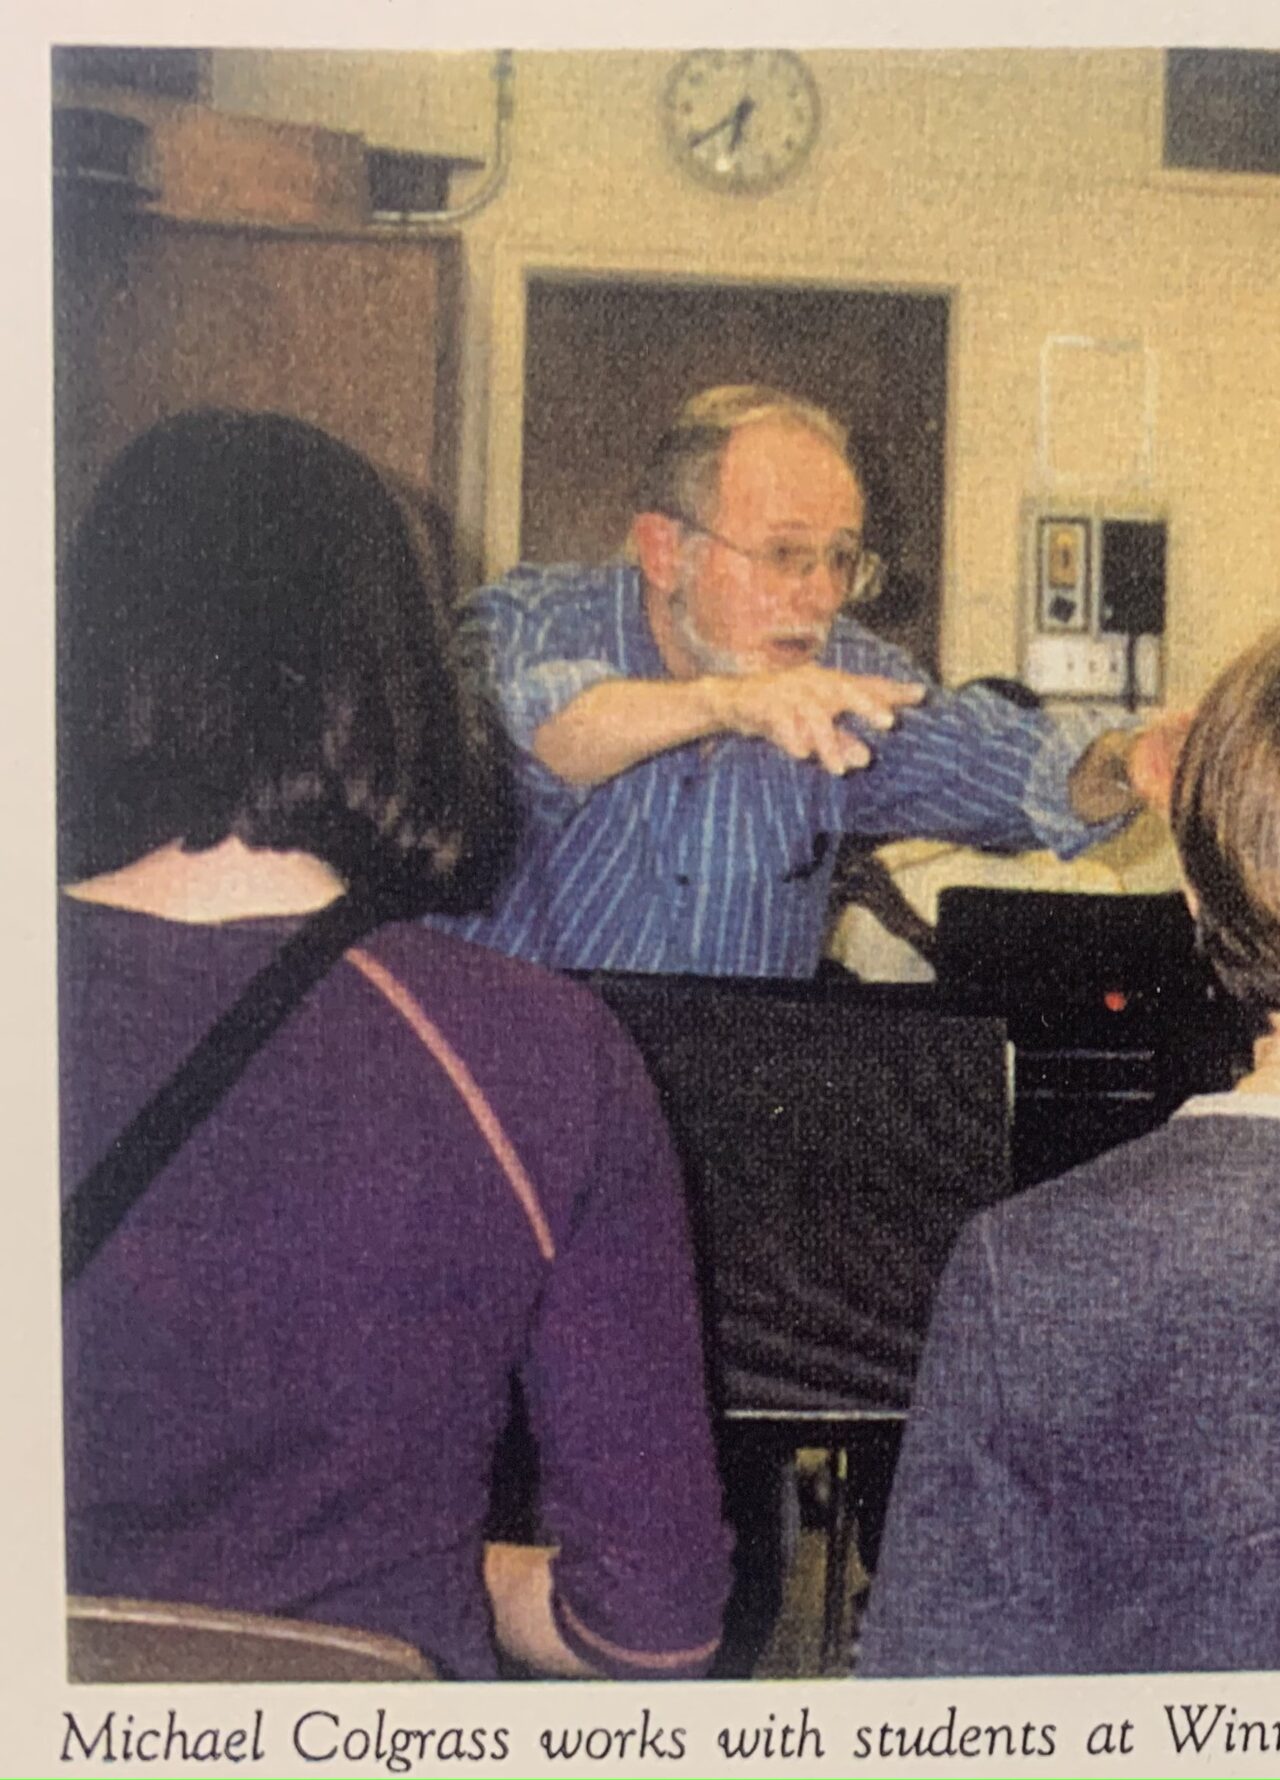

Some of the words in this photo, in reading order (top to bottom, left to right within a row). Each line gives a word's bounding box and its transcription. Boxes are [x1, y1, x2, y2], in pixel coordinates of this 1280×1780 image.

[60, 1709, 264, 1763] Michael
[293, 1709, 509, 1774] Colgrass
[540, 1708, 685, 1760] works
[717, 1707, 825, 1759] with
[853, 1706, 1057, 1759] students
[1086, 1720, 1134, 1756] at
